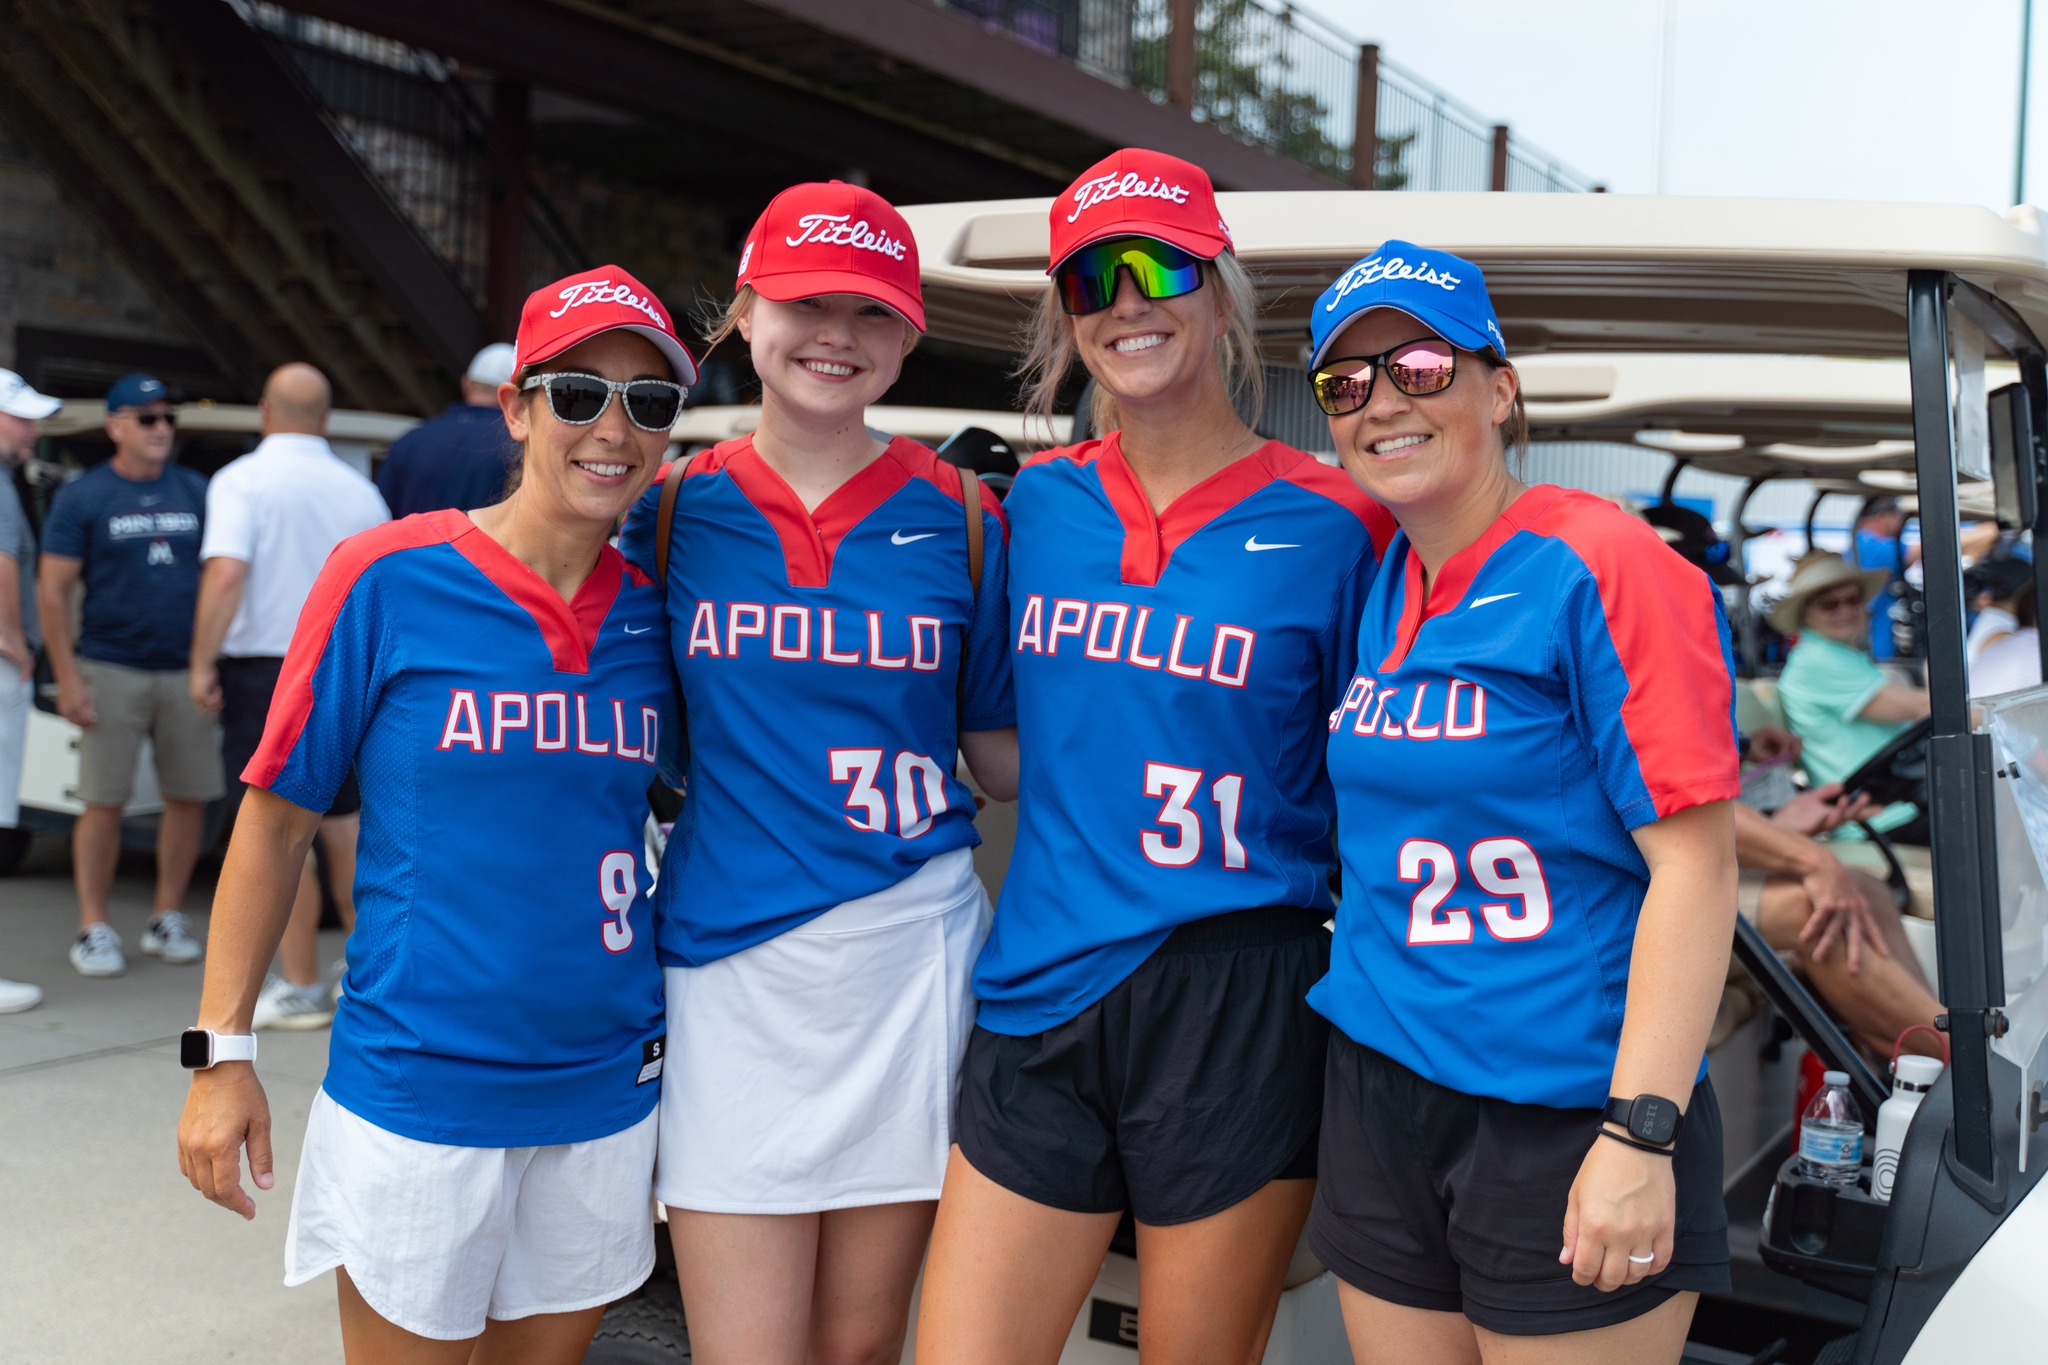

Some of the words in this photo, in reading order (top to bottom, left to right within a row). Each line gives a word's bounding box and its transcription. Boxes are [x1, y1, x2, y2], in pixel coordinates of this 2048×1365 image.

[1068, 171, 1189, 223] Titleist
[786, 214, 907, 261] Titleist
[1326, 256, 1461, 312] Titleist
[686, 600, 942, 673] APOLLO
[1016, 594, 1256, 689] APOLLO
[434, 688, 658, 765] APOLLO
[827, 746, 949, 841] 30
[1140, 760, 1248, 871] 31
[598, 849, 638, 955] 9
[1397, 835, 1553, 947] 29
[653, 1042, 660, 1057] S
[1642, 1103, 1658, 1135] 11:52
